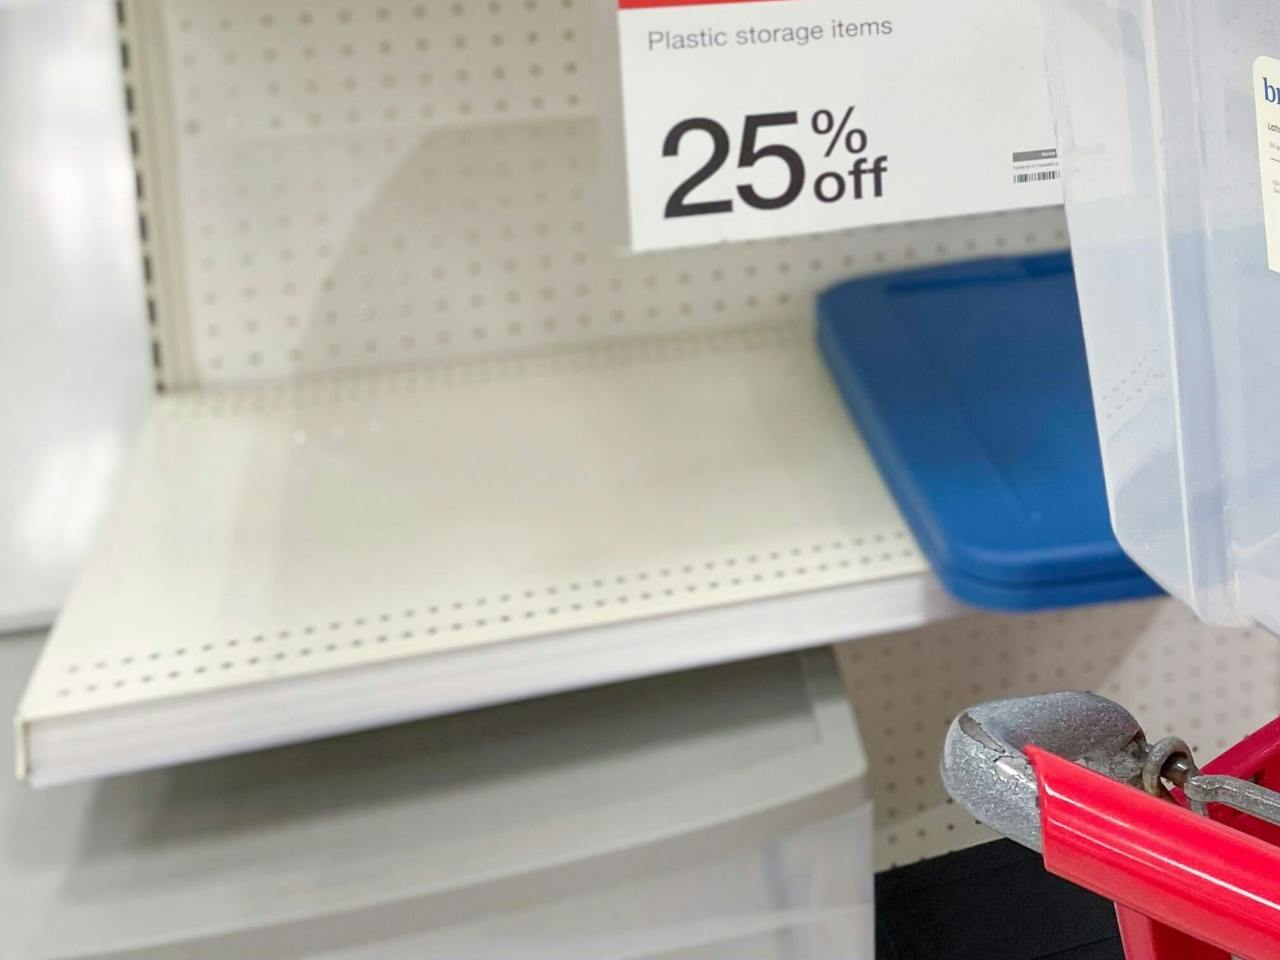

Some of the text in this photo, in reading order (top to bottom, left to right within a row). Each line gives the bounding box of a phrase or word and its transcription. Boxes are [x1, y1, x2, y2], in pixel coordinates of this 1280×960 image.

[647, 19, 893, 51] Plastic storage items
[813, 155, 888, 203] off
